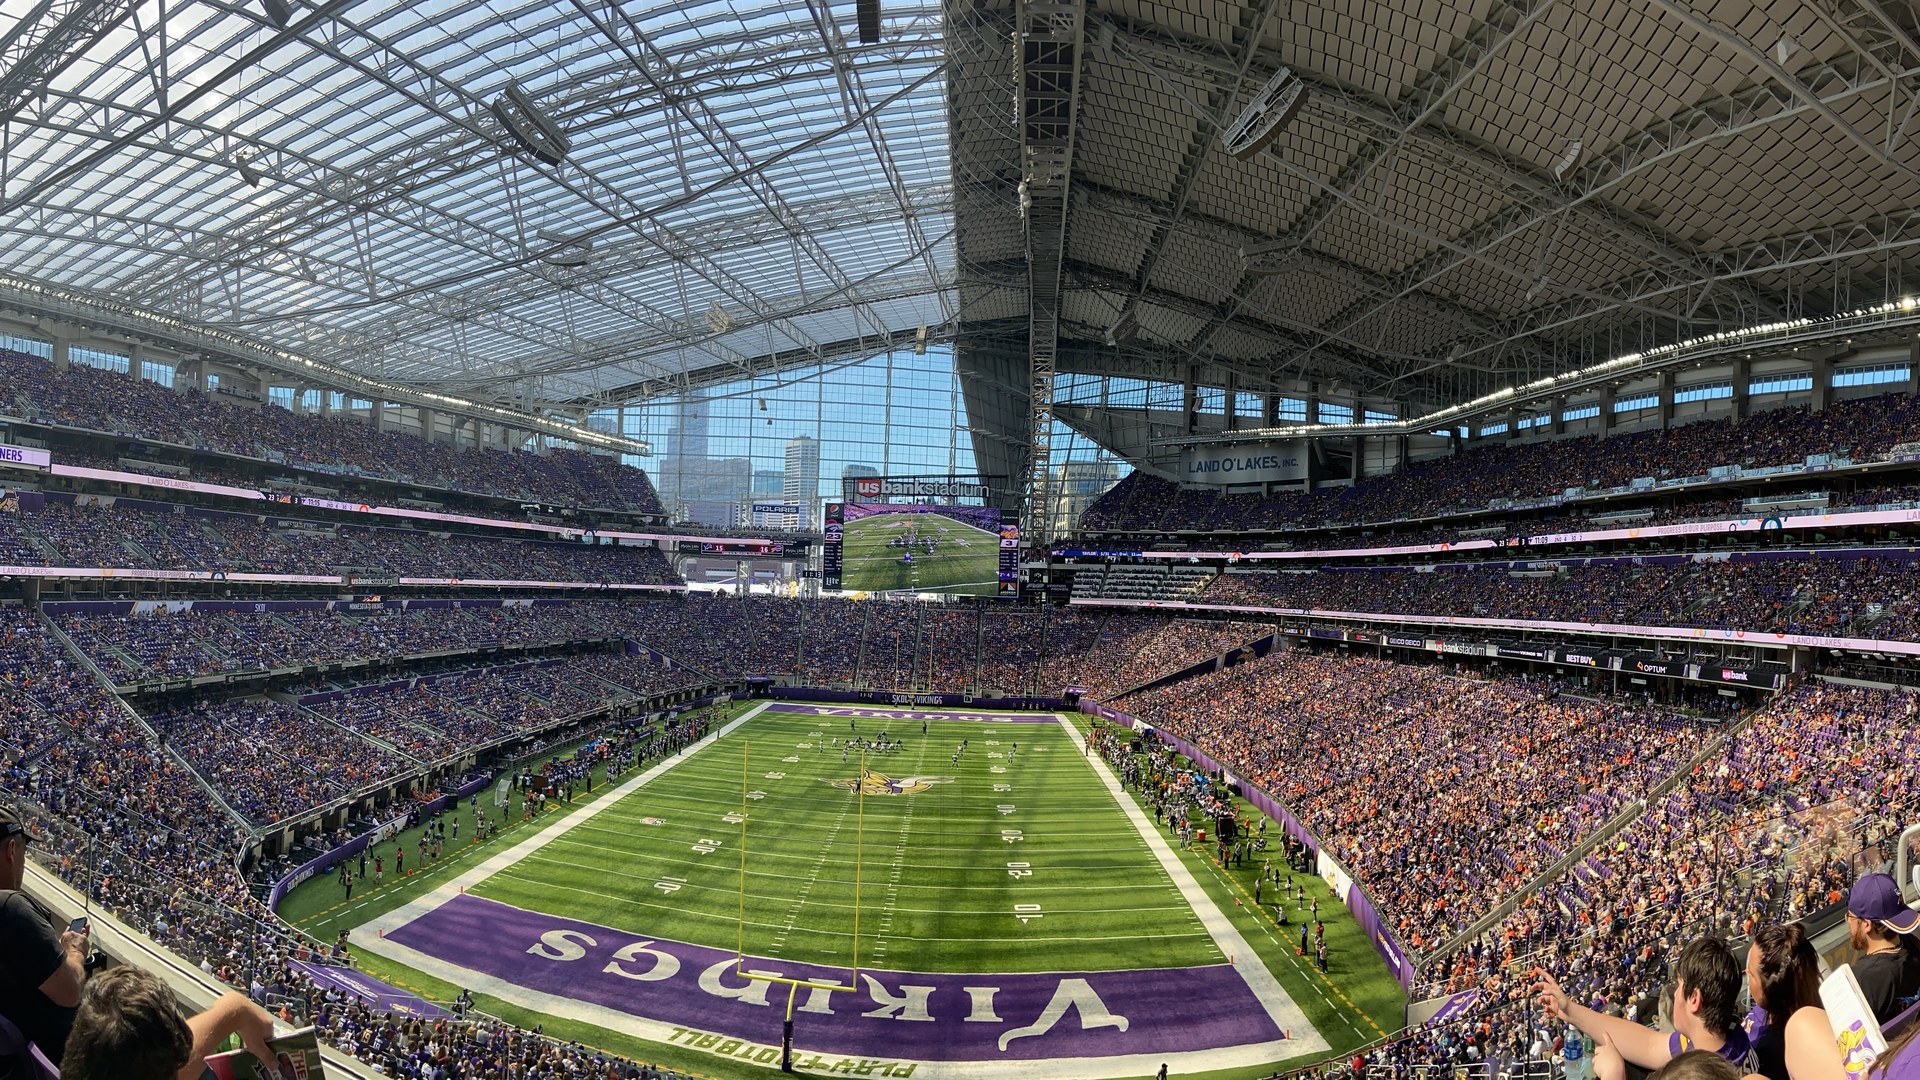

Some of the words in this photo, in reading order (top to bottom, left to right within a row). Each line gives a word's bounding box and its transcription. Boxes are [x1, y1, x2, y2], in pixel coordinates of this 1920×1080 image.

[1188, 460, 1220, 473] LAND
[1282, 458, 1299, 468] INC.
[1657, 526, 1682, 535] PROGRESS
[1534, 536, 1549, 544] 11:09
[825, 576, 840, 586] Lite
[1405, 638, 1421, 646] GEICO
[1792, 636, 1811, 645] LAND
[1566, 654, 1580, 663] BEST
[1580, 656, 1593, 664] BUY
[1643, 664, 1666, 674] OPTUM
[892, 694, 908, 704] SKOL
[916, 695, 943, 705] VIKINGS
[1001, 829, 1024, 841] 30
[691, 838, 723, 853] 20
[299, 865, 315, 880] VIKINGS
[1006, 861, 1033, 876] 20
[653, 876, 688, 891] 10
[1014, 903, 1044, 919] 10
[525, 929, 1130, 1051] VIKINGS
[291, 1049, 308, 1080] THE
